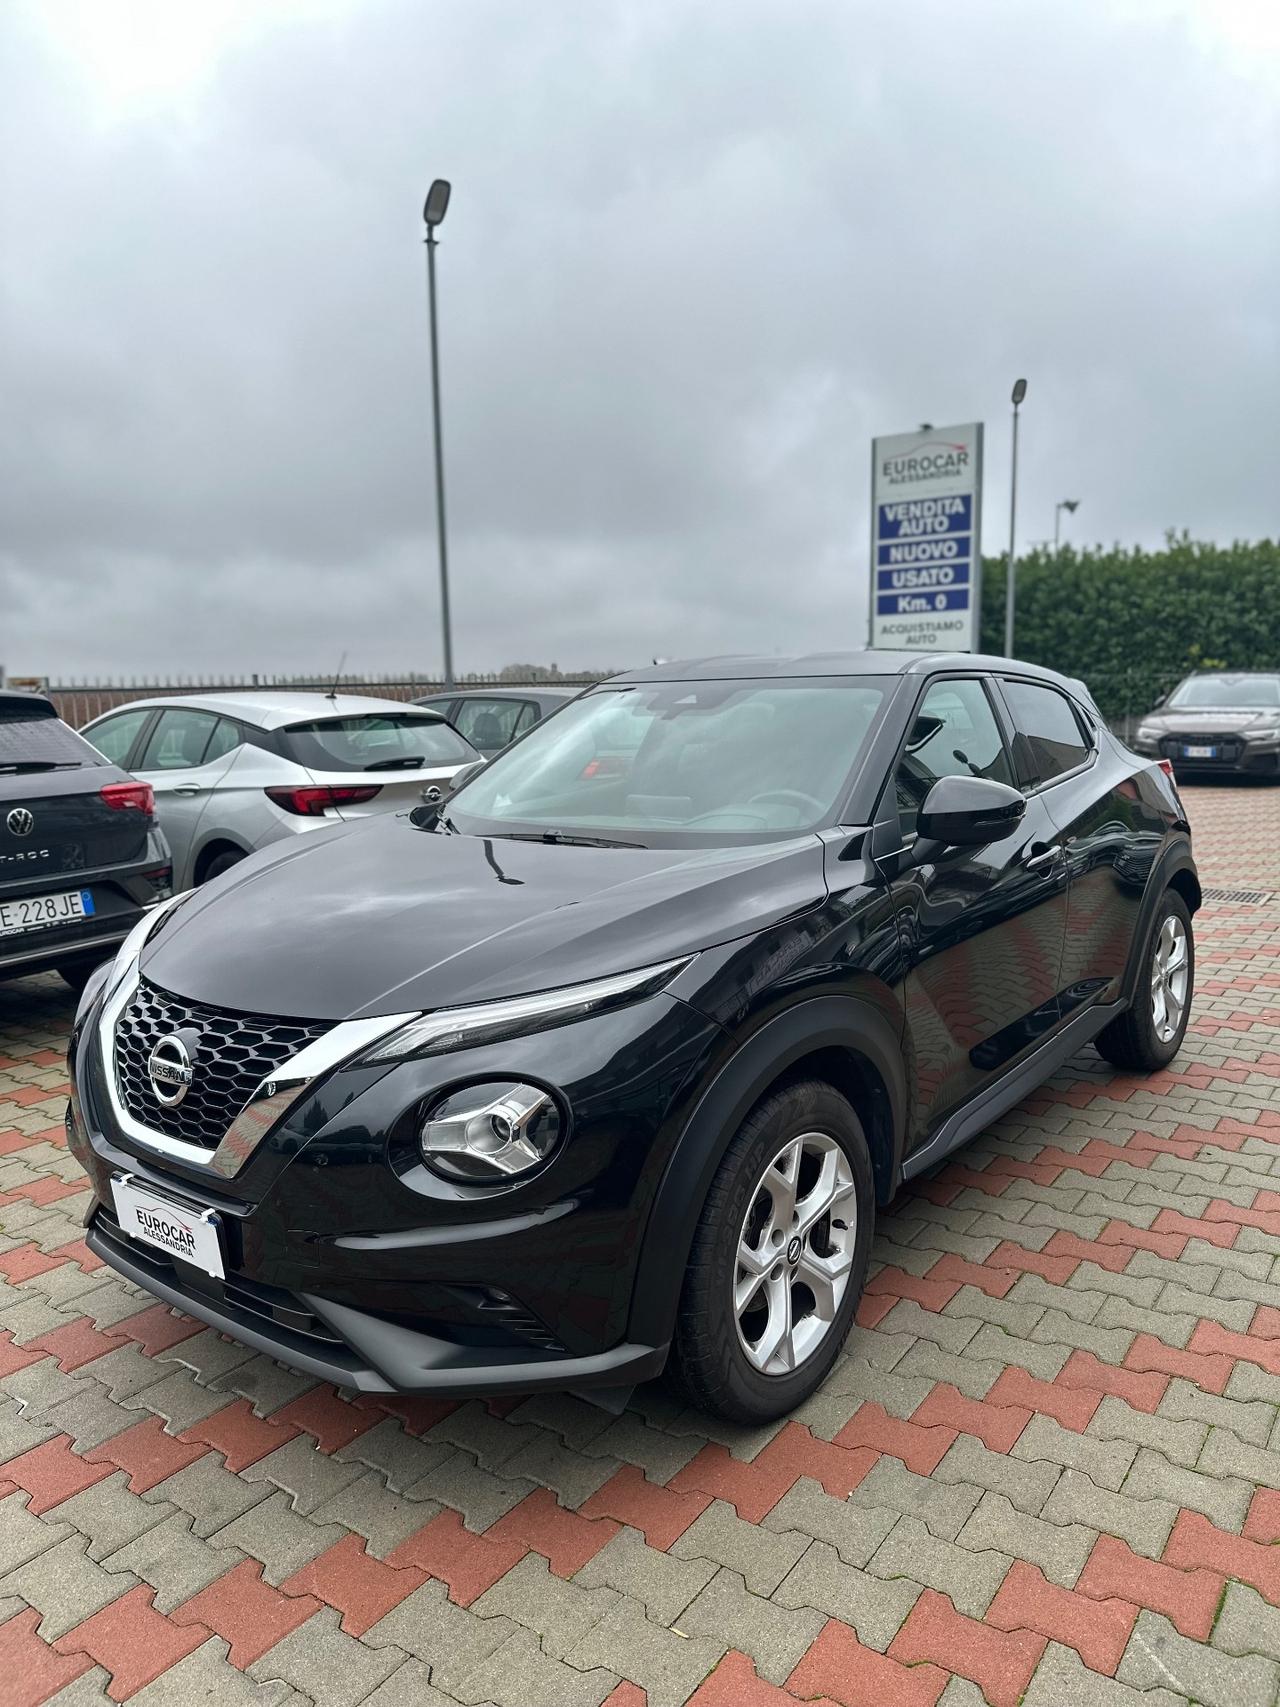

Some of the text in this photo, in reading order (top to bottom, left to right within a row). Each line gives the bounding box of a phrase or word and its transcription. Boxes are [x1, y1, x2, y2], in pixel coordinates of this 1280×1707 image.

[883, 451, 969, 477] EUROCAR
[889, 468, 962, 485] ALESSANDRIA
[885, 498, 965, 522] VENDITA
[898, 516, 949, 537] AUTO
[890, 540, 958, 563] NUOVO
[892, 567, 954, 588] USATO
[897, 593, 947, 613] Km. 0
[881, 620, 963, 636] ACQUISTIAMO
[906, 633, 937, 646] AUTO
[0, 927, 25, 937] UROCAR
[150, 1061, 185, 1083] NISSAN
[136, 1208, 196, 1250] EUROCAR
[143, 1227, 194, 1258] ALESSANDRIA
